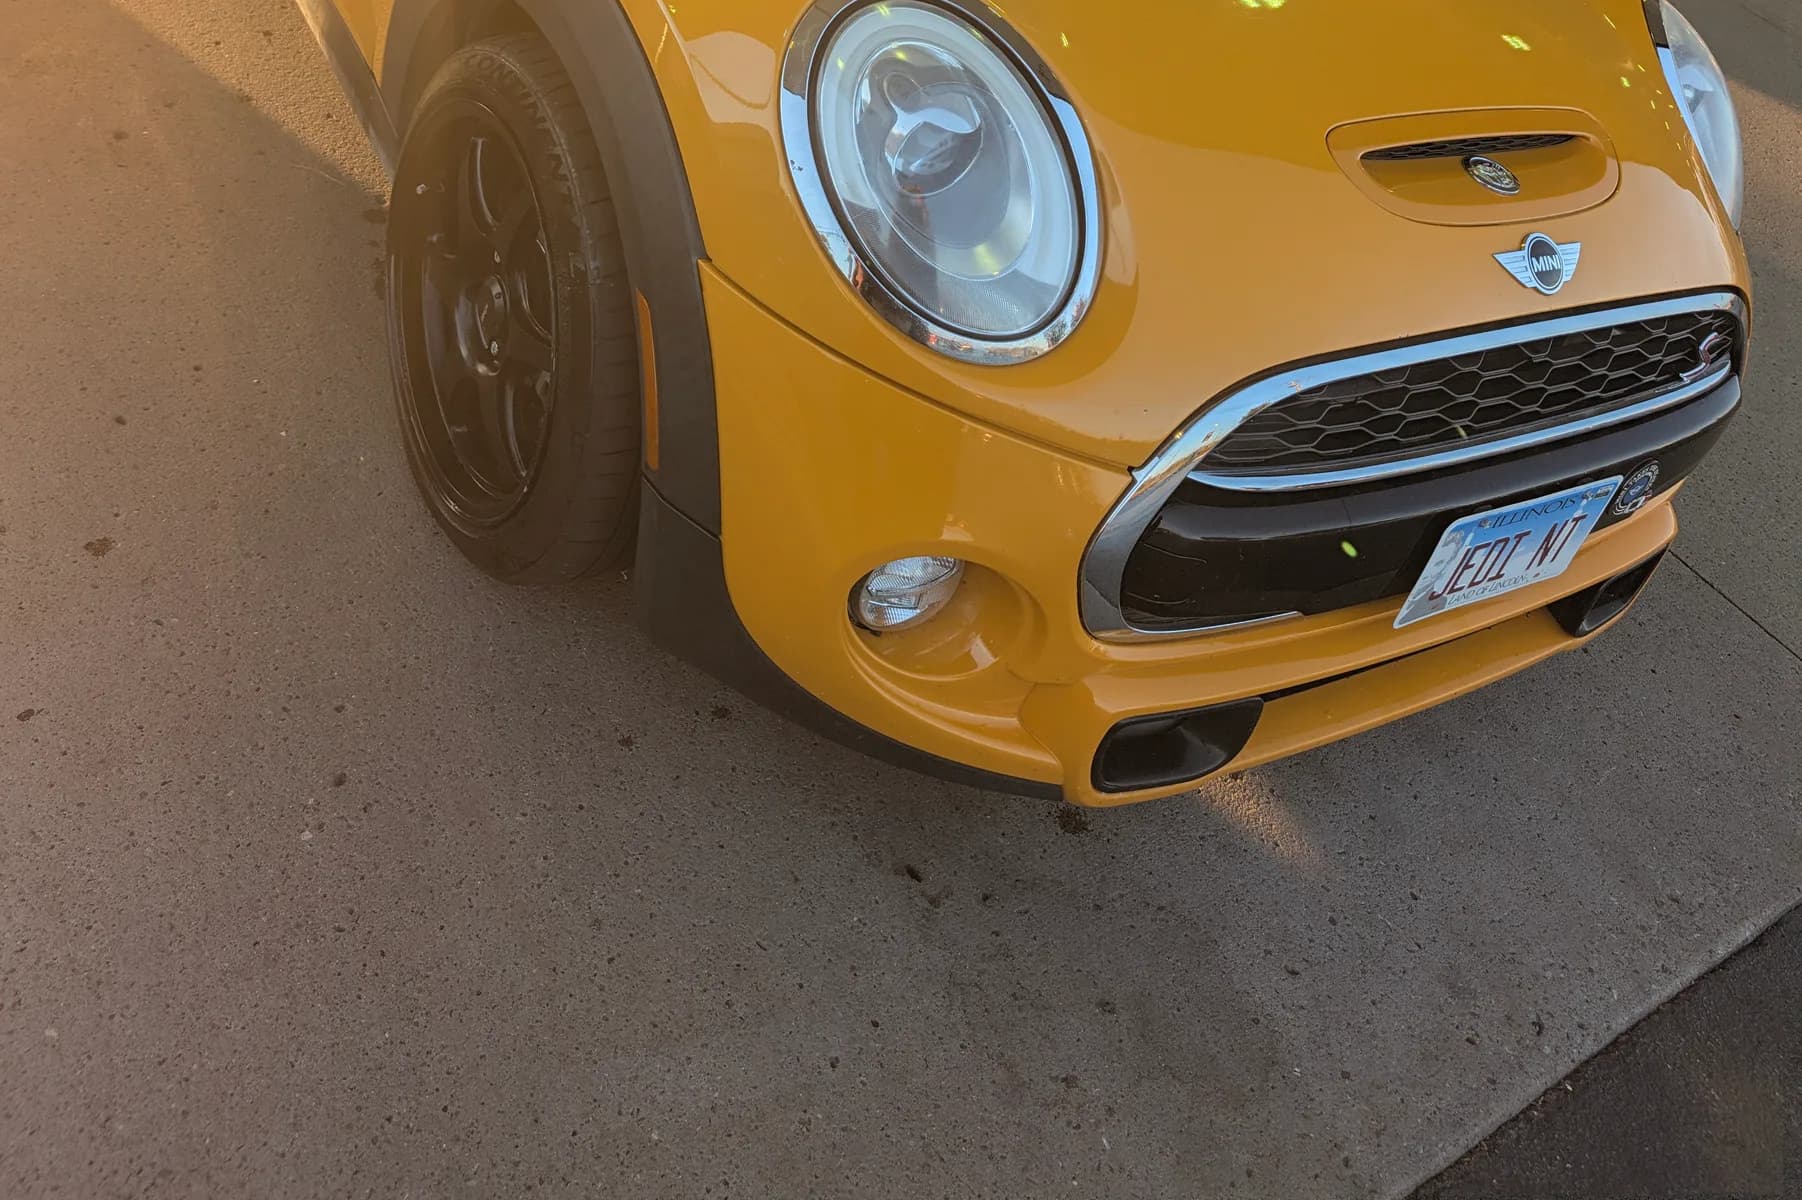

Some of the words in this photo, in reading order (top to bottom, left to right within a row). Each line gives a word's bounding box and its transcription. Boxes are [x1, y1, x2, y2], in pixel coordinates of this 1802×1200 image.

[1531, 254, 1562, 273] MINI
[1491, 498, 1576, 529] ILLINOIS
[1428, 530, 1532, 601] JEDI
[1525, 514, 1588, 571] NT
